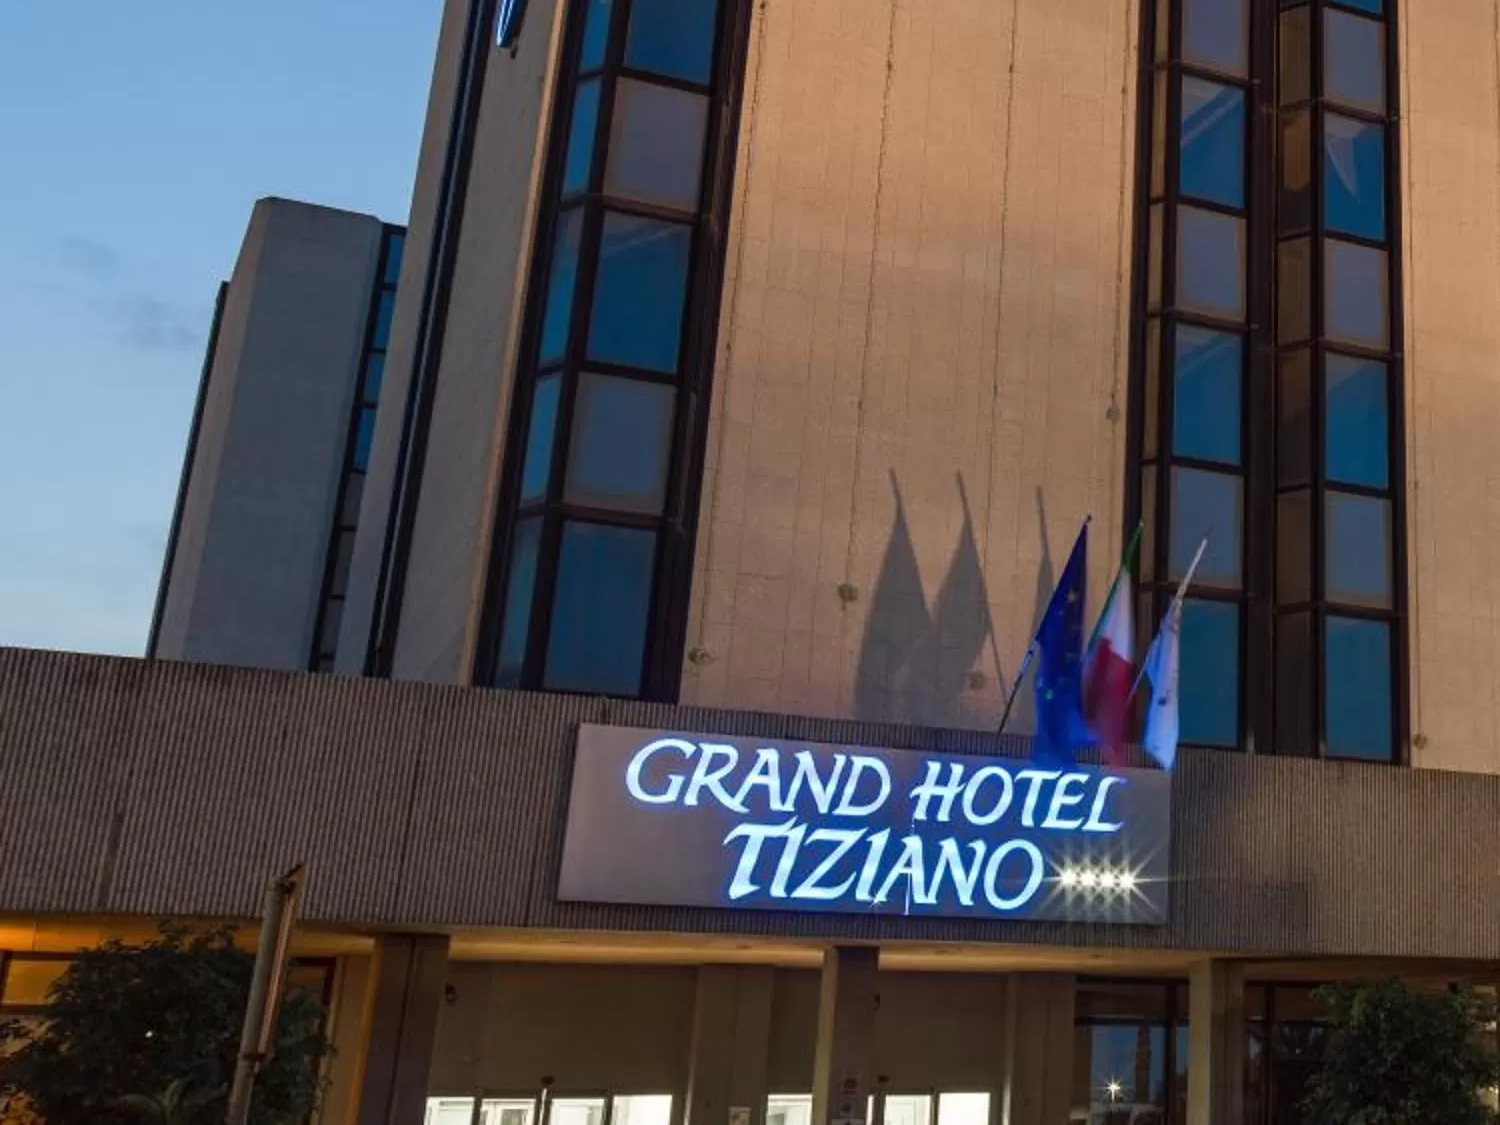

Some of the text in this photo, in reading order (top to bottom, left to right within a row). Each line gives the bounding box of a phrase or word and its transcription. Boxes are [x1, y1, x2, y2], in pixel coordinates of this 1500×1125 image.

[624, 737, 1129, 833] GRAND HOTEL
[721, 814, 1045, 911] TIZIANO
